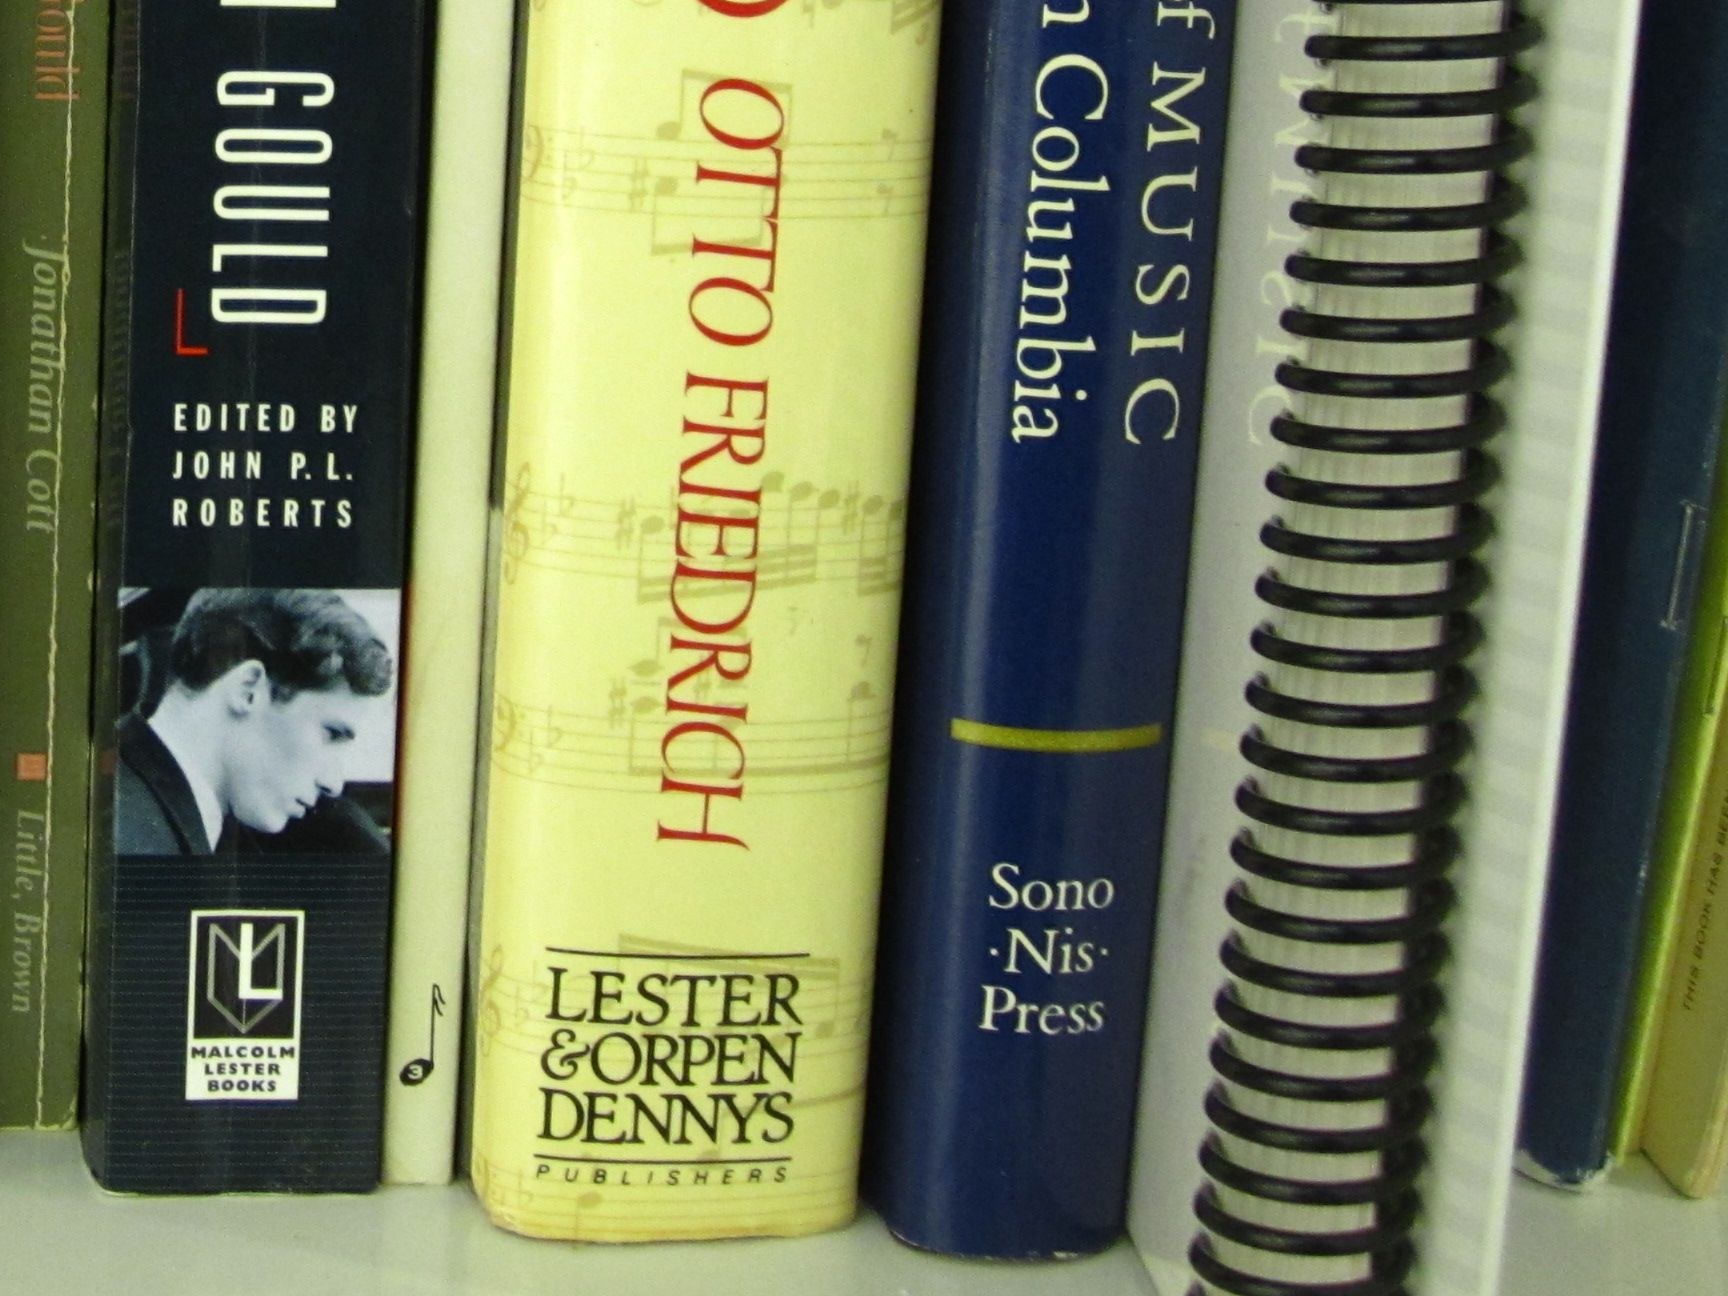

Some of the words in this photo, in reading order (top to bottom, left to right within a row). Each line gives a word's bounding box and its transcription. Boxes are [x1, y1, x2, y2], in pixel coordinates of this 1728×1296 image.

[210, 70, 335, 324] GOULD
[688, 78, 784, 347] OTTO
[1012, 54, 1110, 444] Columbia
[1123, 65, 1207, 444] MUSIC
[24, 240, 67, 434] Jonathan
[173, 404, 296, 433] EDITED
[321, 405, 359, 432] BY
[25, 449, 61, 532] Cott
[173, 452, 262, 480] JOHN
[290, 452, 313, 480] P.
[326, 452, 353, 480] L.
[173, 499, 353, 529] ROBERTS
[656, 373, 769, 852] FRIEDRICH
[988, 864, 1115, 911] Sono
[1683, 968, 1700, 1010] THIS
[1694, 904, 1711, 959] BOOK
[1706, 852, 1723, 894] HAS
[12, 912, 39, 1012] Brown
[545, 966, 803, 1027] LESTER
[979, 985, 1105, 1034] Press
[191, 1046, 295, 1059] MALCOLM
[205, 1063, 280, 1075] LESTER
[208, 1080, 276, 1092] BOOKS
[537, 1087, 794, 1144] DENNYS
[536, 1164, 787, 1185] PUBLISHERS
